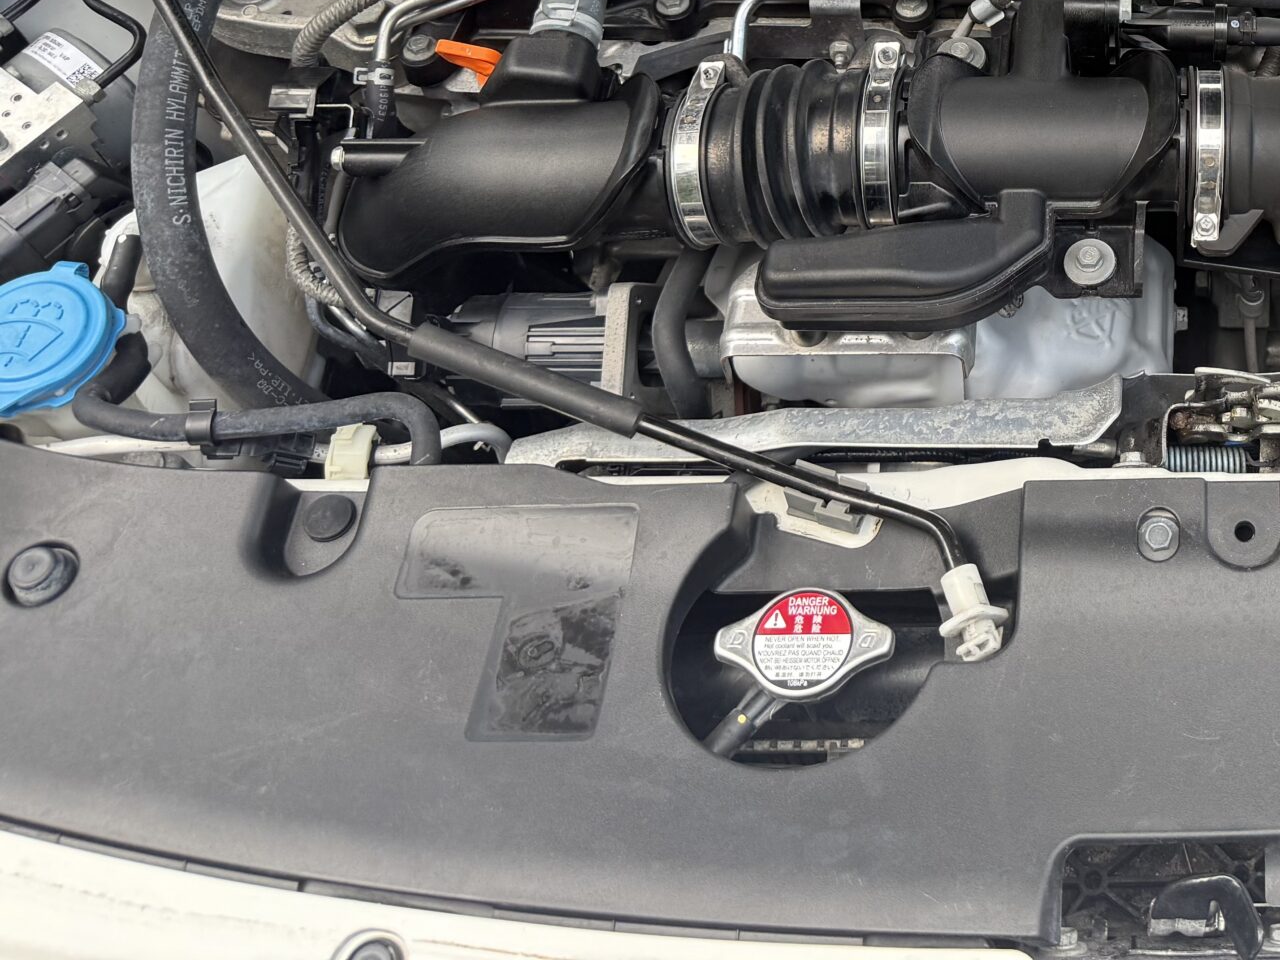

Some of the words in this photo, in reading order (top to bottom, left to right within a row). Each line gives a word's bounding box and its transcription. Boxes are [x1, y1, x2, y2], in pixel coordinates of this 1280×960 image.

[788, 596, 829, 606] DANGER
[788, 605, 838, 616] WARNUNG
[787, 649, 800, 657] PAS
